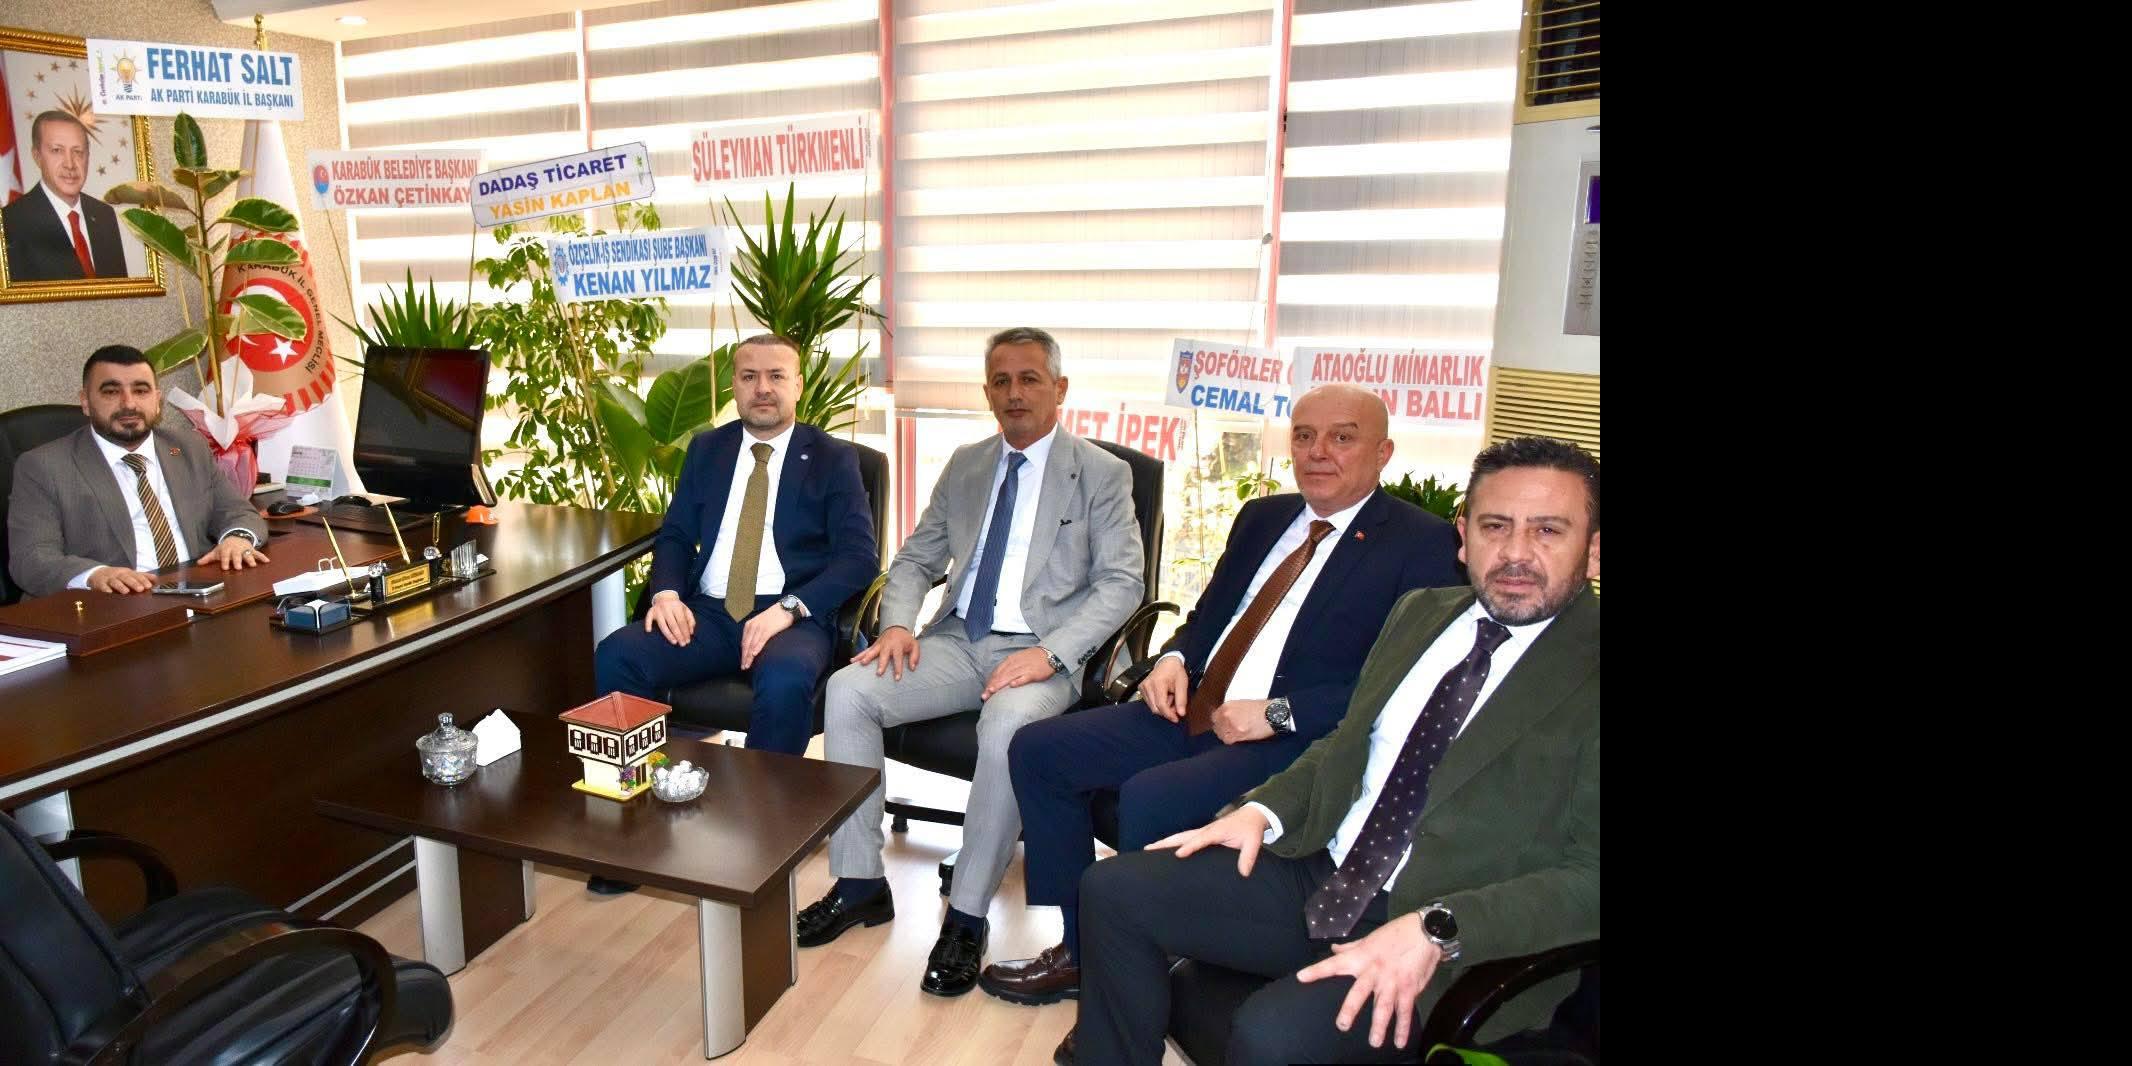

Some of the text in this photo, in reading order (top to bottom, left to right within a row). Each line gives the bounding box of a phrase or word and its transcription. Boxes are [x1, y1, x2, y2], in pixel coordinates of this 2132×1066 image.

[147, 47, 232, 83] FERHAT
[241, 53, 293, 86] SALT
[151, 86, 294, 110] AK PARTİ KARABÜK İL BAŞKANI
[692, 131, 774, 182] SÜLEYMAN
[776, 116, 864, 175] TÜRKMENLİ
[332, 154, 478, 184] KARABÜK BELEDİYE BAŞKANI
[479, 154, 627, 196] DADAŞ TİCARET
[333, 185, 390, 205] ÖZKAN
[490, 181, 631, 219] YASİN KAPLAN
[611, 234, 652, 263] SENDİKASI
[652, 237, 672, 266] ŞUBE
[674, 234, 708, 264] BAŞKANI
[574, 265, 711, 297] KENAN YILMAZ
[1193, 349, 1284, 385] ŞOFÖRLER
[1312, 348, 1389, 384] ATAOĞLU
[1392, 348, 1485, 387] MİMARLIK
[1191, 384, 1265, 415] CEMAL
[1406, 389, 1482, 421] BALLI
[1114, 402, 1180, 461] İPEK
